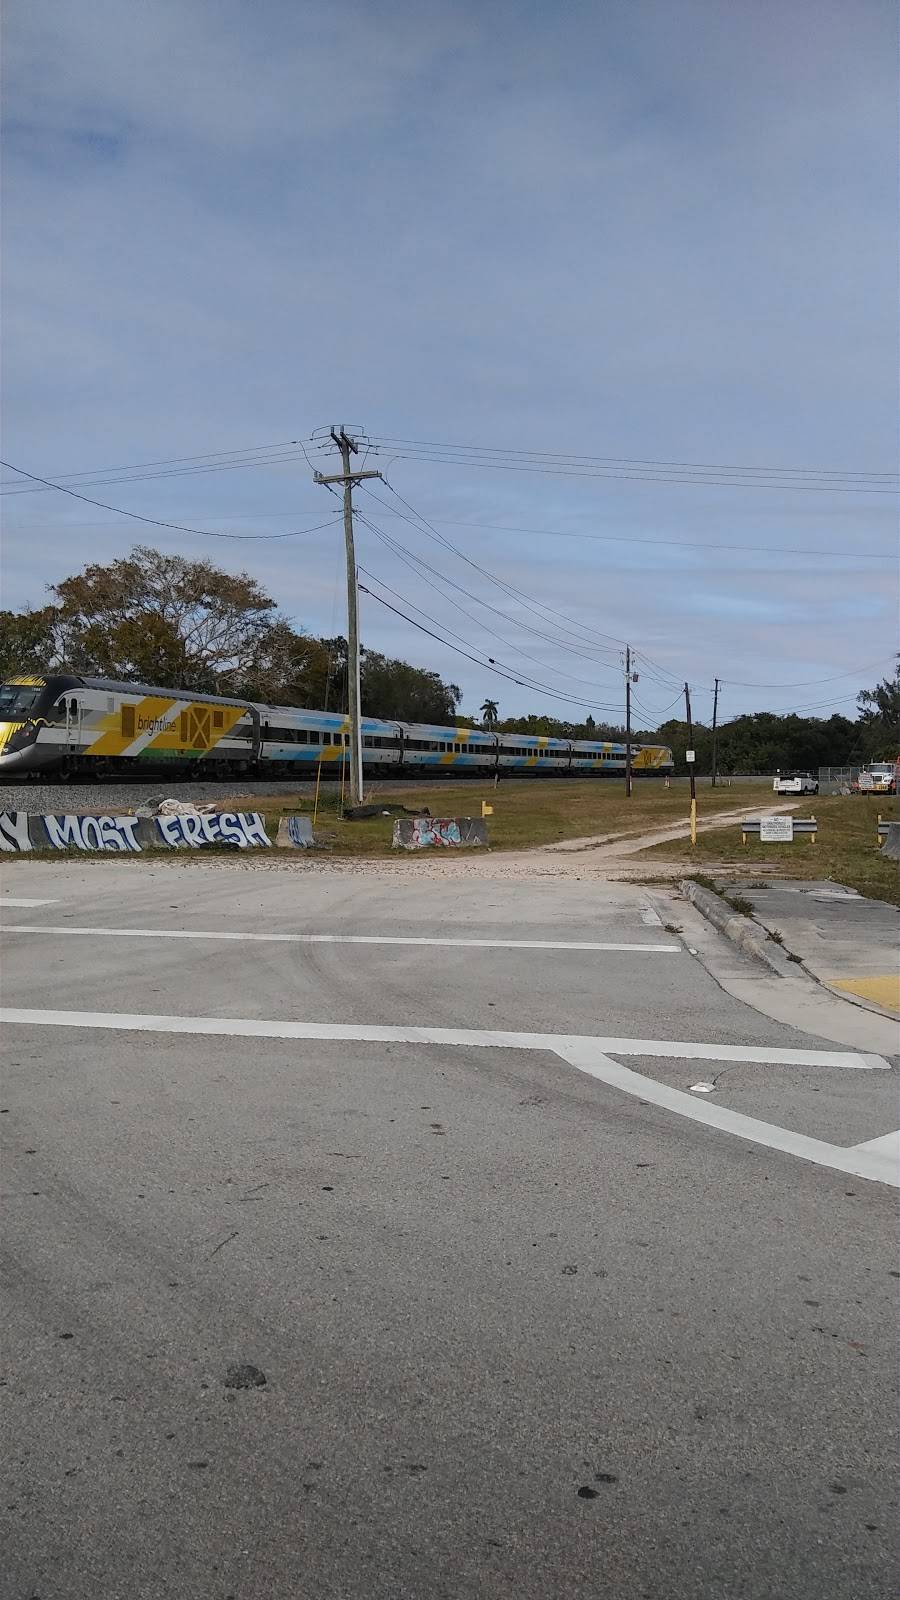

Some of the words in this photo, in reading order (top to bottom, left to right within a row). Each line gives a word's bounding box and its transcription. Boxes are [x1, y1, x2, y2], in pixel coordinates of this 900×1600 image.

[138, 714, 176, 736] brightline
[44, 815, 142, 851] MOST
[154, 813, 272, 848] FRESH
